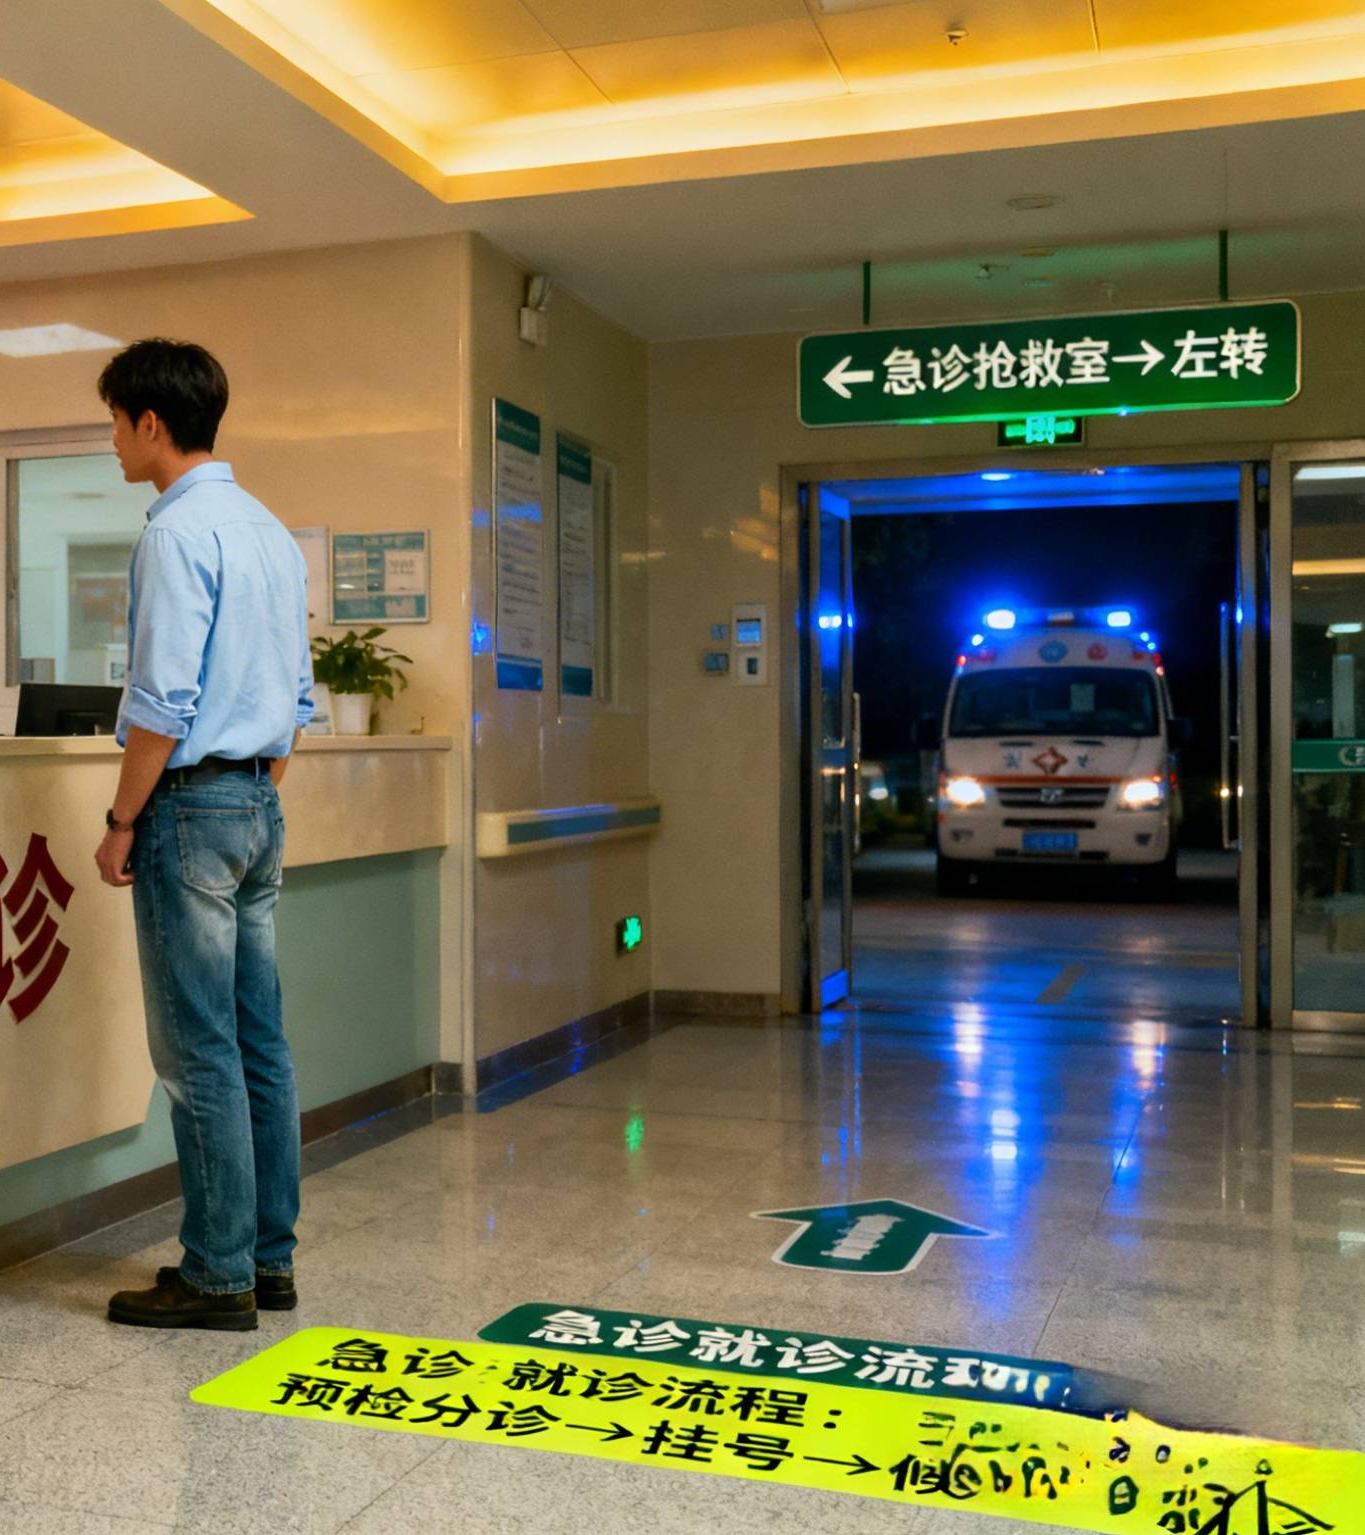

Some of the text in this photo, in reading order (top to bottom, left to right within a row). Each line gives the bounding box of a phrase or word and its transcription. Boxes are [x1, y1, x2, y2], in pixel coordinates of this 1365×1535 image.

[882, 327, 1269, 396] 急诊抢救室 左转
[270, 1372, 561, 1437] 预检分诊
[640, 1420, 795, 1472] 挂号
